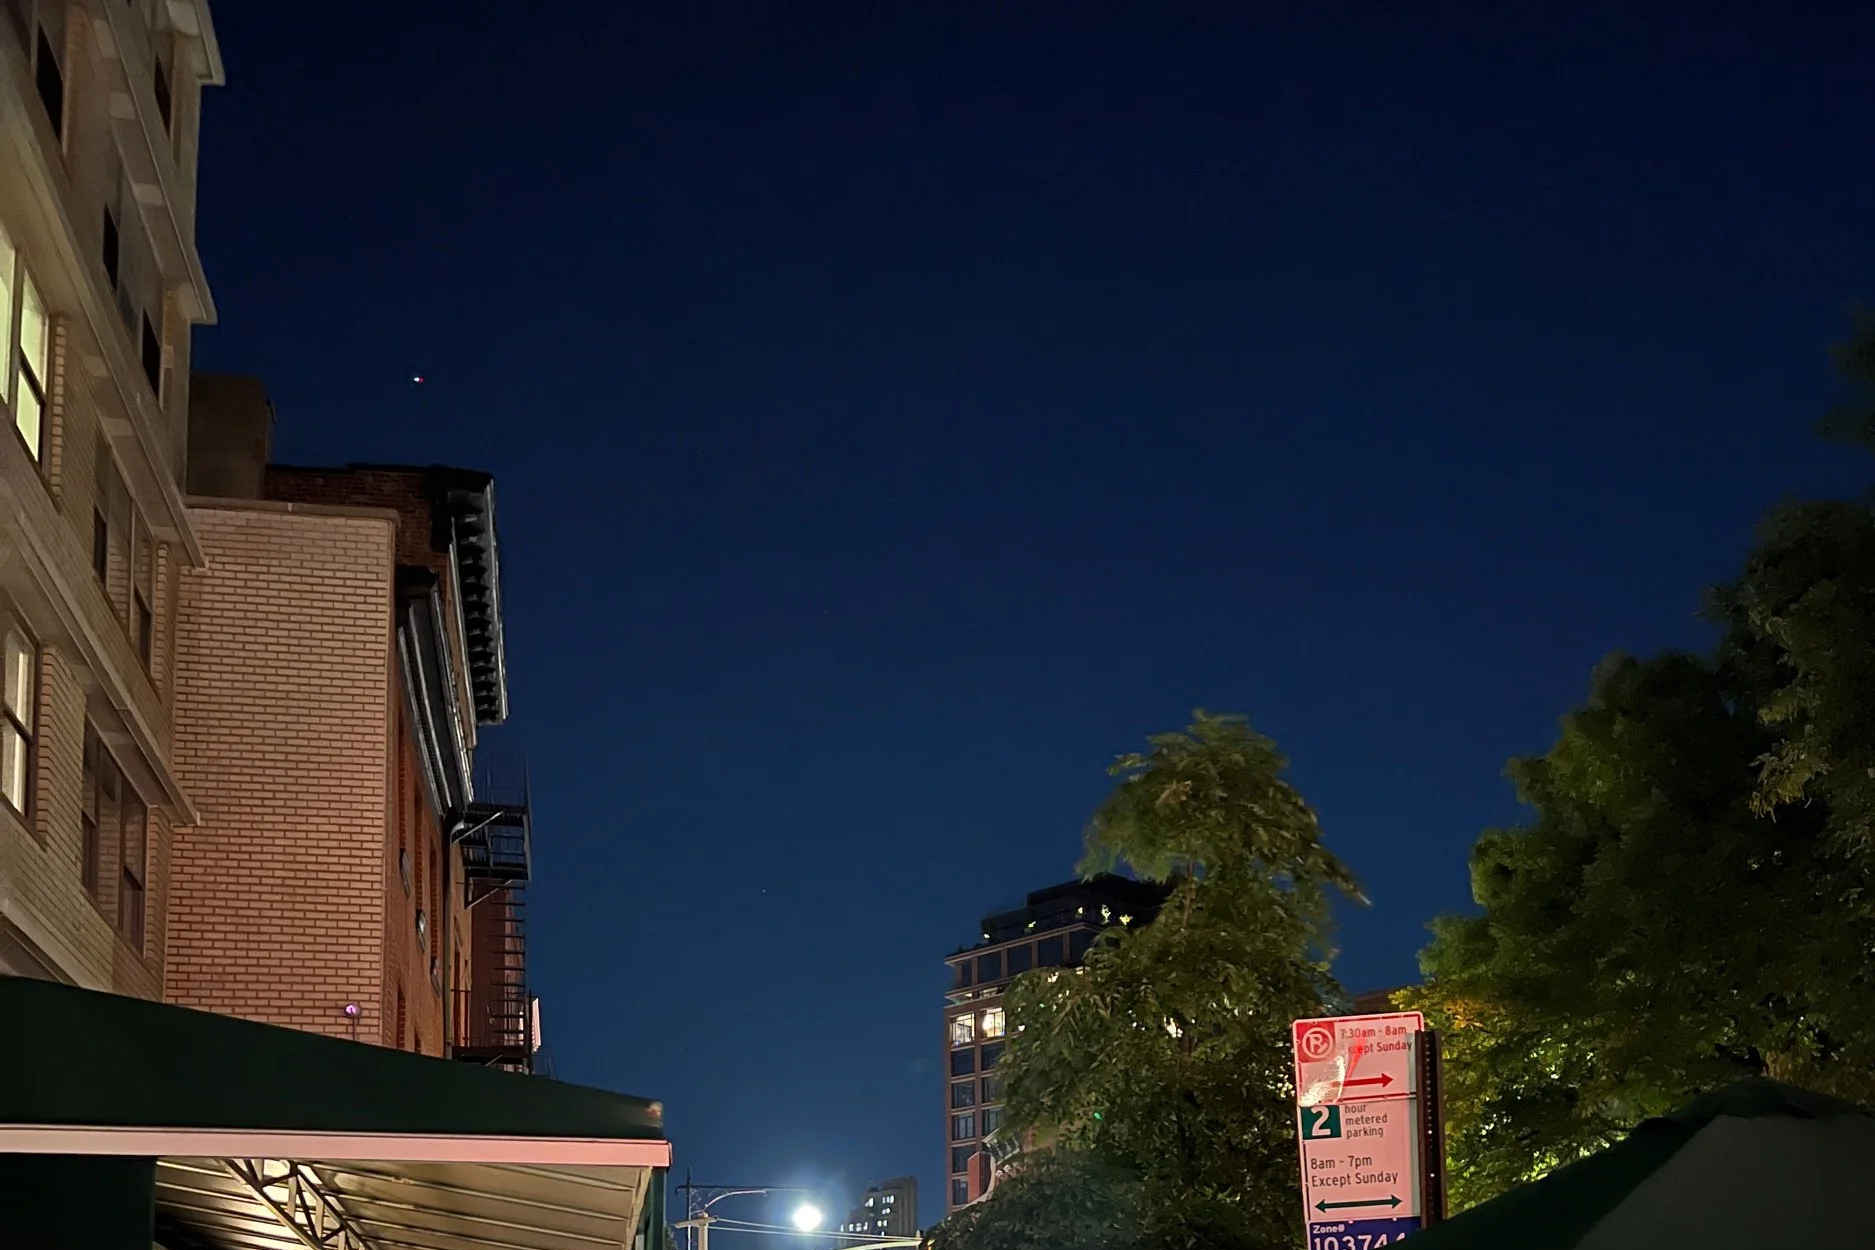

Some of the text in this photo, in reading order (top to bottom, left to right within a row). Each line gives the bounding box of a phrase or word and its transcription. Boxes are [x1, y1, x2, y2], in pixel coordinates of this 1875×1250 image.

[1385, 1025, 1407, 1036] 8am
[1344, 1040, 1412, 1055] xcept Sunday
[1344, 1104, 1367, 1114] hour
[1310, 1105, 1331, 1137] 2
[1345, 1113, 1388, 1126] metered
[1346, 1127, 1384, 1140] parking
[1310, 1158, 1335, 1170] 8am
[1347, 1155, 1372, 1169] 7pm
[1311, 1171, 1398, 1188] Except Sunday
[1313, 1224, 1345, 1234] Zone#
